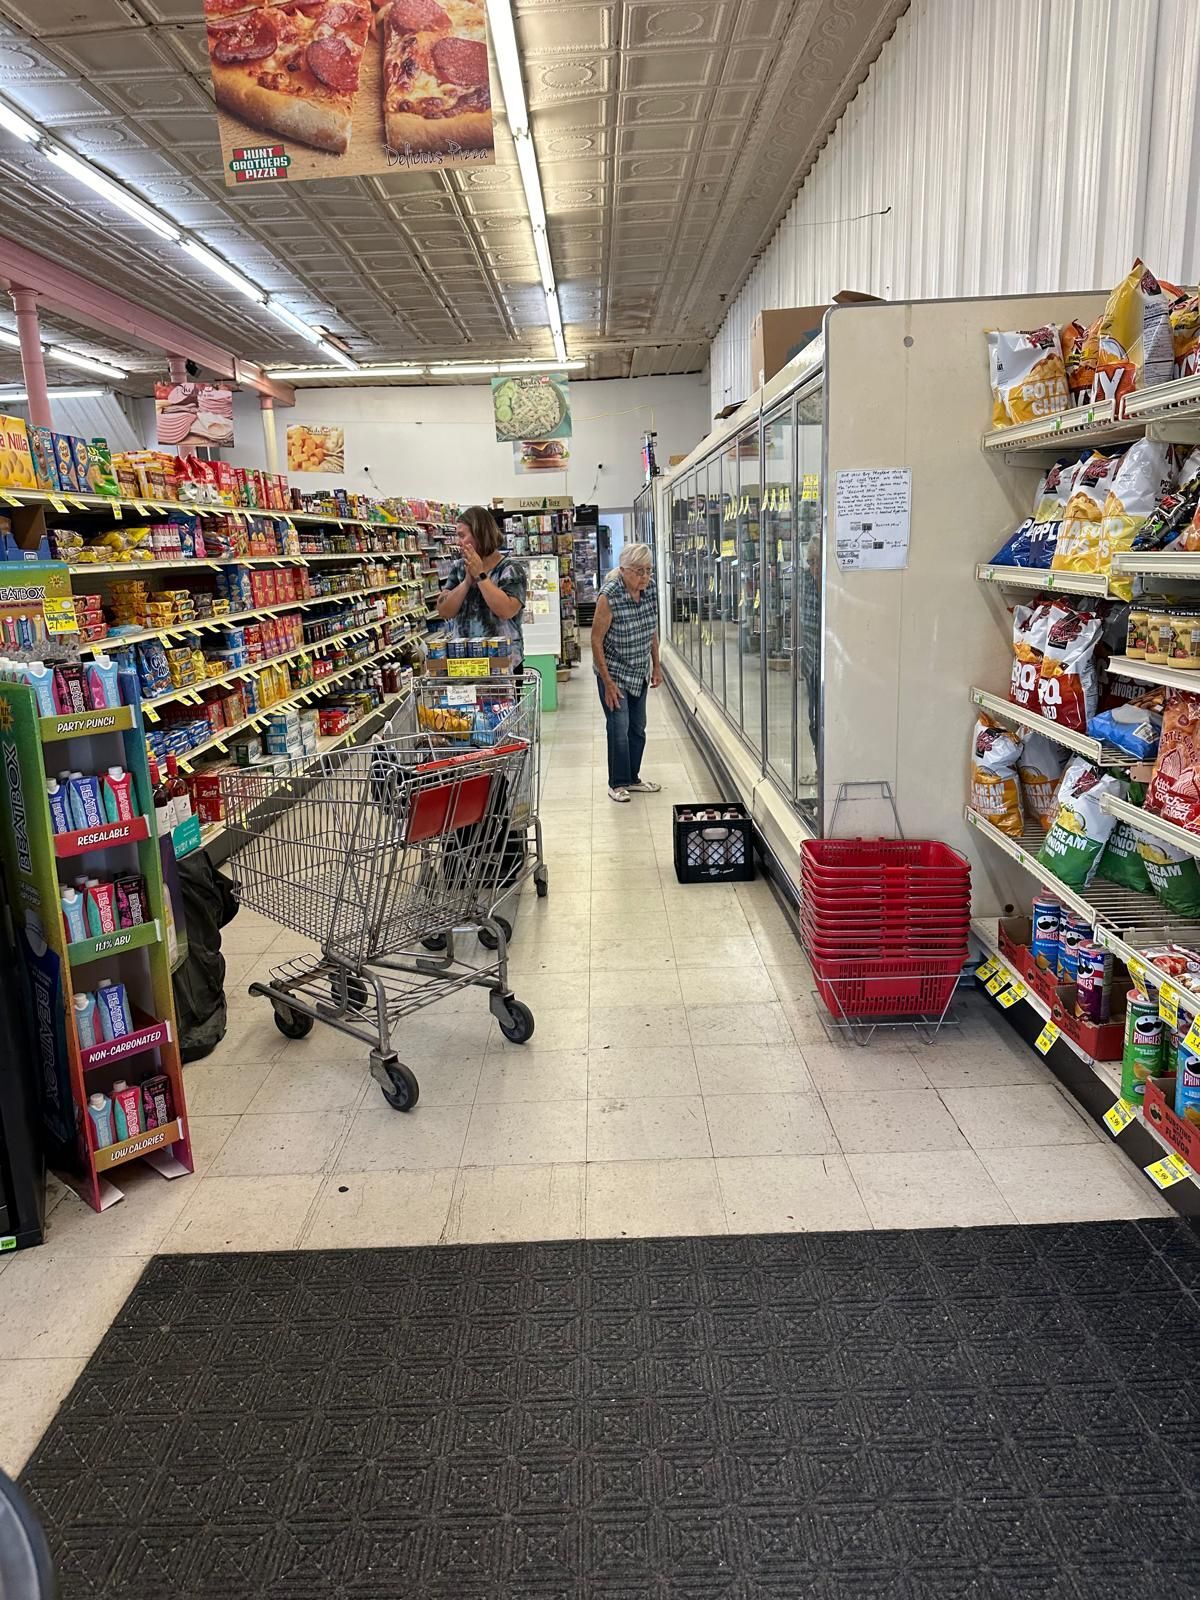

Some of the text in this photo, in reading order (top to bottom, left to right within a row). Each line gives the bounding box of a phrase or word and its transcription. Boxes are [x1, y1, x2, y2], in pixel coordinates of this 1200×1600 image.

[243, 147, 274, 160] HUNT
[383, 139, 488, 168] Delicious Pizza
[232, 156, 288, 171] BROTHERS
[245, 167, 278, 179] PIZZA
[1023, 379, 1065, 401] POTA
[1032, 398, 1068, 416] CHIP
[7, 431, 29, 452] Nilla
[0, 586, 46, 601] EATBOX
[57, 716, 115, 733] PARTY PUNCH
[2, 741, 33, 875] BEATBOX
[77, 826, 129, 846] RESEALABLE
[1052, 825, 1088, 851] CREAM
[1144, 860, 1182, 876] CREAM
[1035, 928, 1059, 941] PRINGLES
[95, 940, 113, 952] 11.1%
[1133, 1031, 1161, 1045] PRINGLES
[89, 1031, 161, 1063] NON-CARBONATED
[1184, 1072, 1200, 1086] PRIN
[111, 1133, 165, 1161] LOW CALORIES
